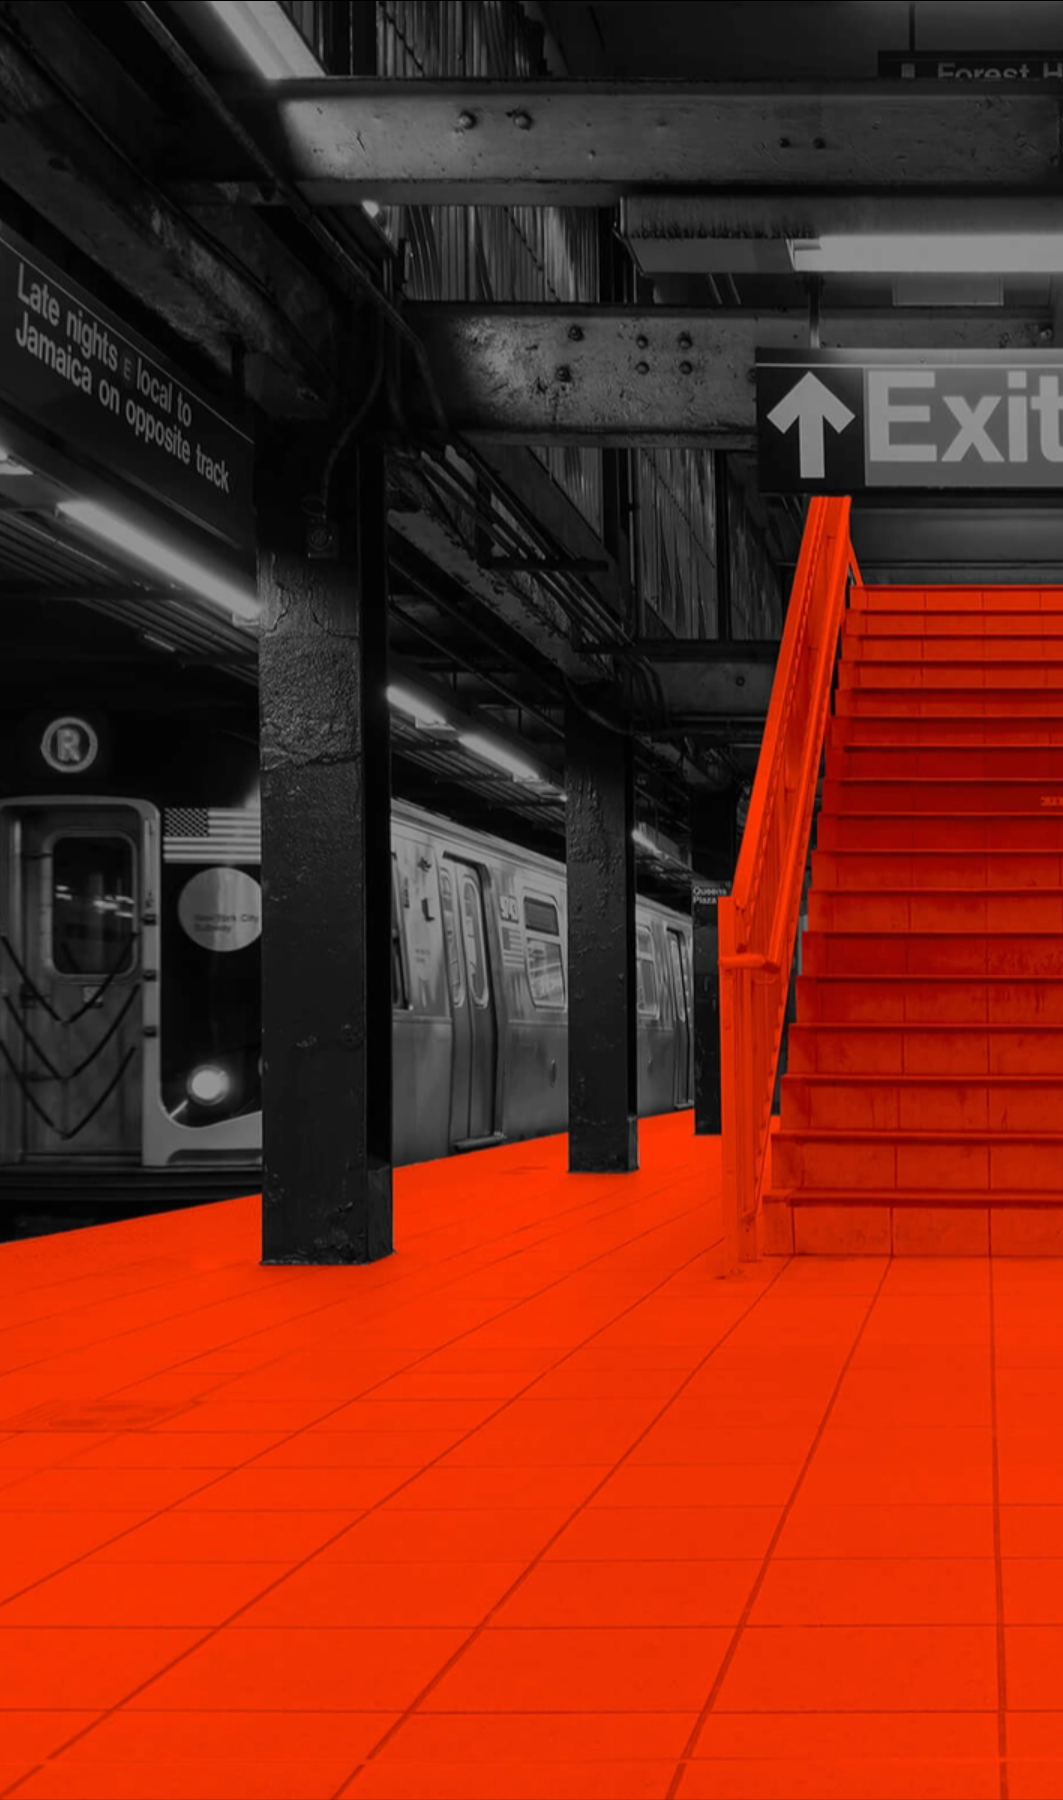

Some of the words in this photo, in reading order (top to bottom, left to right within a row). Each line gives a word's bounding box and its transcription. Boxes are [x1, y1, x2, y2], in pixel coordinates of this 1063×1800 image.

[16, 311, 93, 396] Jamaica
[99, 378, 121, 416] on
[125, 399, 192, 465] opposite
[195, 443, 230, 494] track
[18, 261, 61, 328] Late
[66, 307, 119, 373] nights
[123, 357, 133, 382] E
[136, 357, 172, 415] local
[176, 391, 193, 429] to
[56, 728, 82, 762] R
